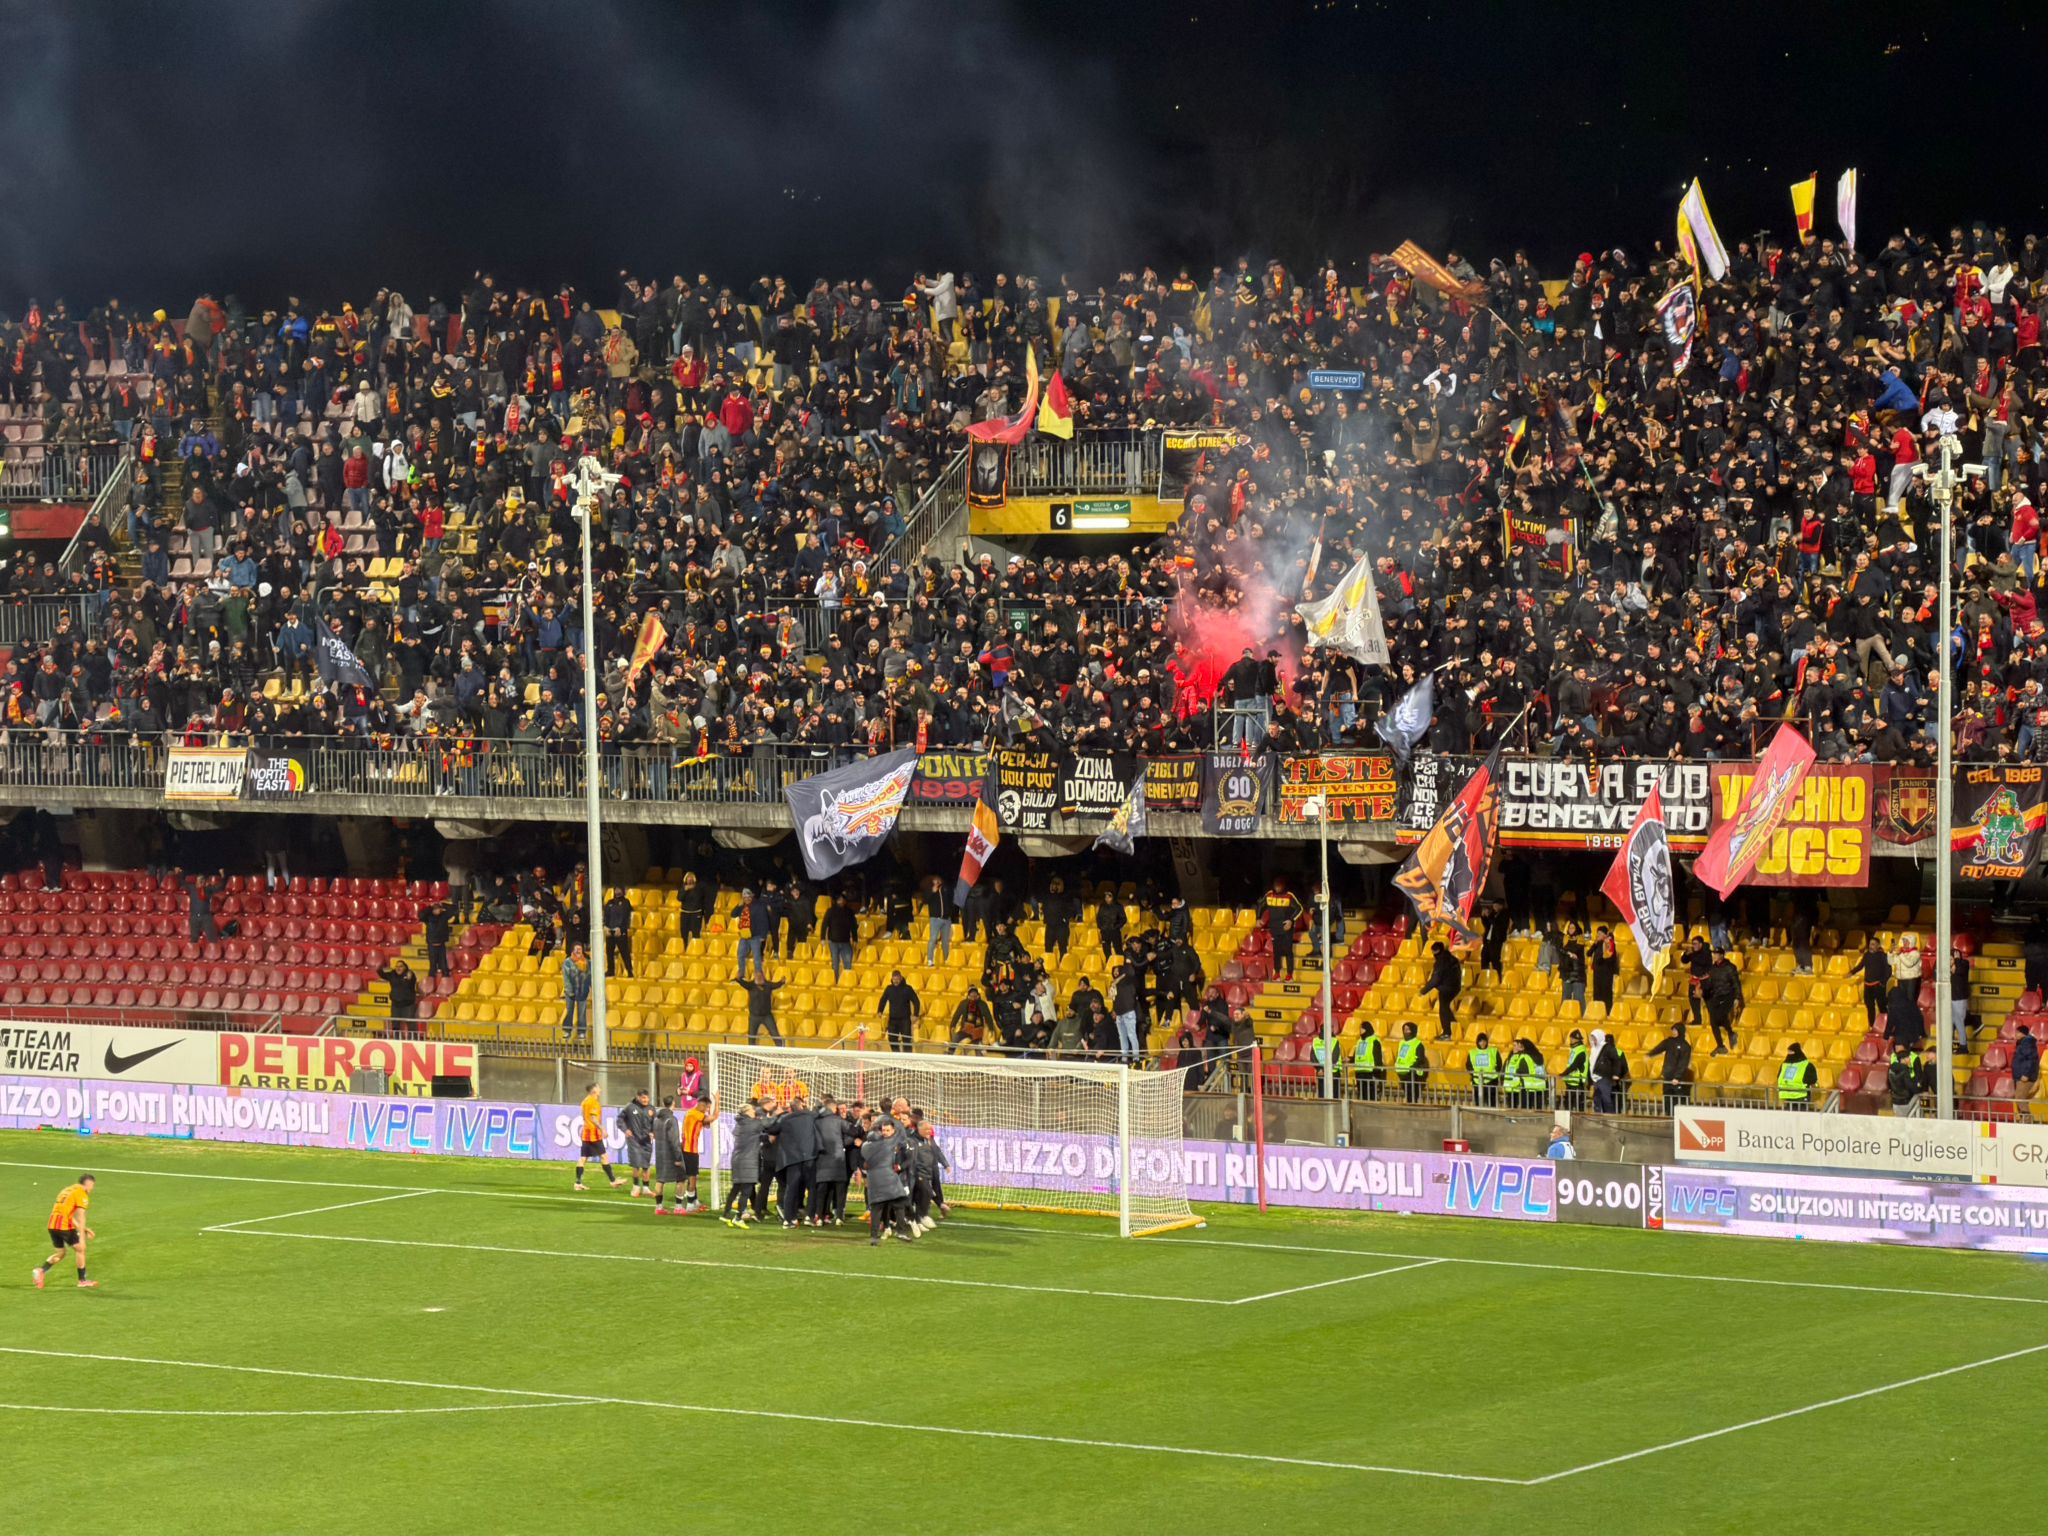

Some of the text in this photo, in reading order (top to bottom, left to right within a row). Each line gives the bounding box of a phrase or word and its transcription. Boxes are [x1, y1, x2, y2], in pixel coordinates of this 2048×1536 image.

[1314, 375, 1357, 384] BENEVENTO
[1055, 508, 1066, 525] 6
[1511, 518, 1546, 534] ULTIMI
[268, 758, 288, 769] THE
[1001, 751, 1025, 767] PER
[1074, 757, 1114, 779] ZONA
[1146, 761, 1196, 778] FIGLI DI
[1213, 755, 1241, 768] DAGLI
[1283, 757, 1394, 782] TESTE
[1414, 761, 1438, 775] PER
[170, 761, 243, 784] PIETRELCINA
[251, 768, 288, 780] NORTH
[1001, 769, 1024, 787] NON
[1416, 774, 1436, 789] CHI
[1506, 762, 1709, 800] CURVA SUD
[1966, 767, 2042, 784] DAL 1982
[256, 779, 285, 791] EAST
[1228, 776, 1251, 799] 90
[1412, 788, 1438, 803] NON
[1022, 791, 1057, 808] GIULIO
[1279, 795, 1396, 822] MTTE
[1891, 788, 1900, 819] NOSTRA
[1022, 812, 1047, 828] VIVE
[1219, 817, 1232, 831] AD
[1504, 802, 1709, 831] BENEVETO
[1585, 835, 1623, 848] 1929
[1960, 865, 1982, 880] AD
[13, 1028, 71, 1050] TEAM
[18, 1051, 80, 1072] WEAR
[238, 1074, 430, 1097] ARREDANT
[66, 1088, 91, 1120] DI
[96, 1090, 167, 1124] FONTI
[172, 1093, 329, 1134] RINNOVABILI
[346, 1099, 436, 1148] IVPC
[443, 1104, 536, 1154] IVPC
[1738, 1130, 1968, 1162] Banca Popolare Pugliese
[1094, 1145, 1121, 1179] DI
[1130, 1148, 1217, 1187] FONTI
[1225, 1152, 1423, 1197] RINNOVABILI
[1445, 1158, 1556, 1215] IVPC
[1558, 1178, 1642, 1210] 90:00
[1671, 1185, 1737, 1216] IVPC
[1750, 1193, 1853, 1218] SOLUZIONI
[1858, 1200, 1962, 1224] INTEGRATE
[1964, 1205, 2010, 1228] CON
